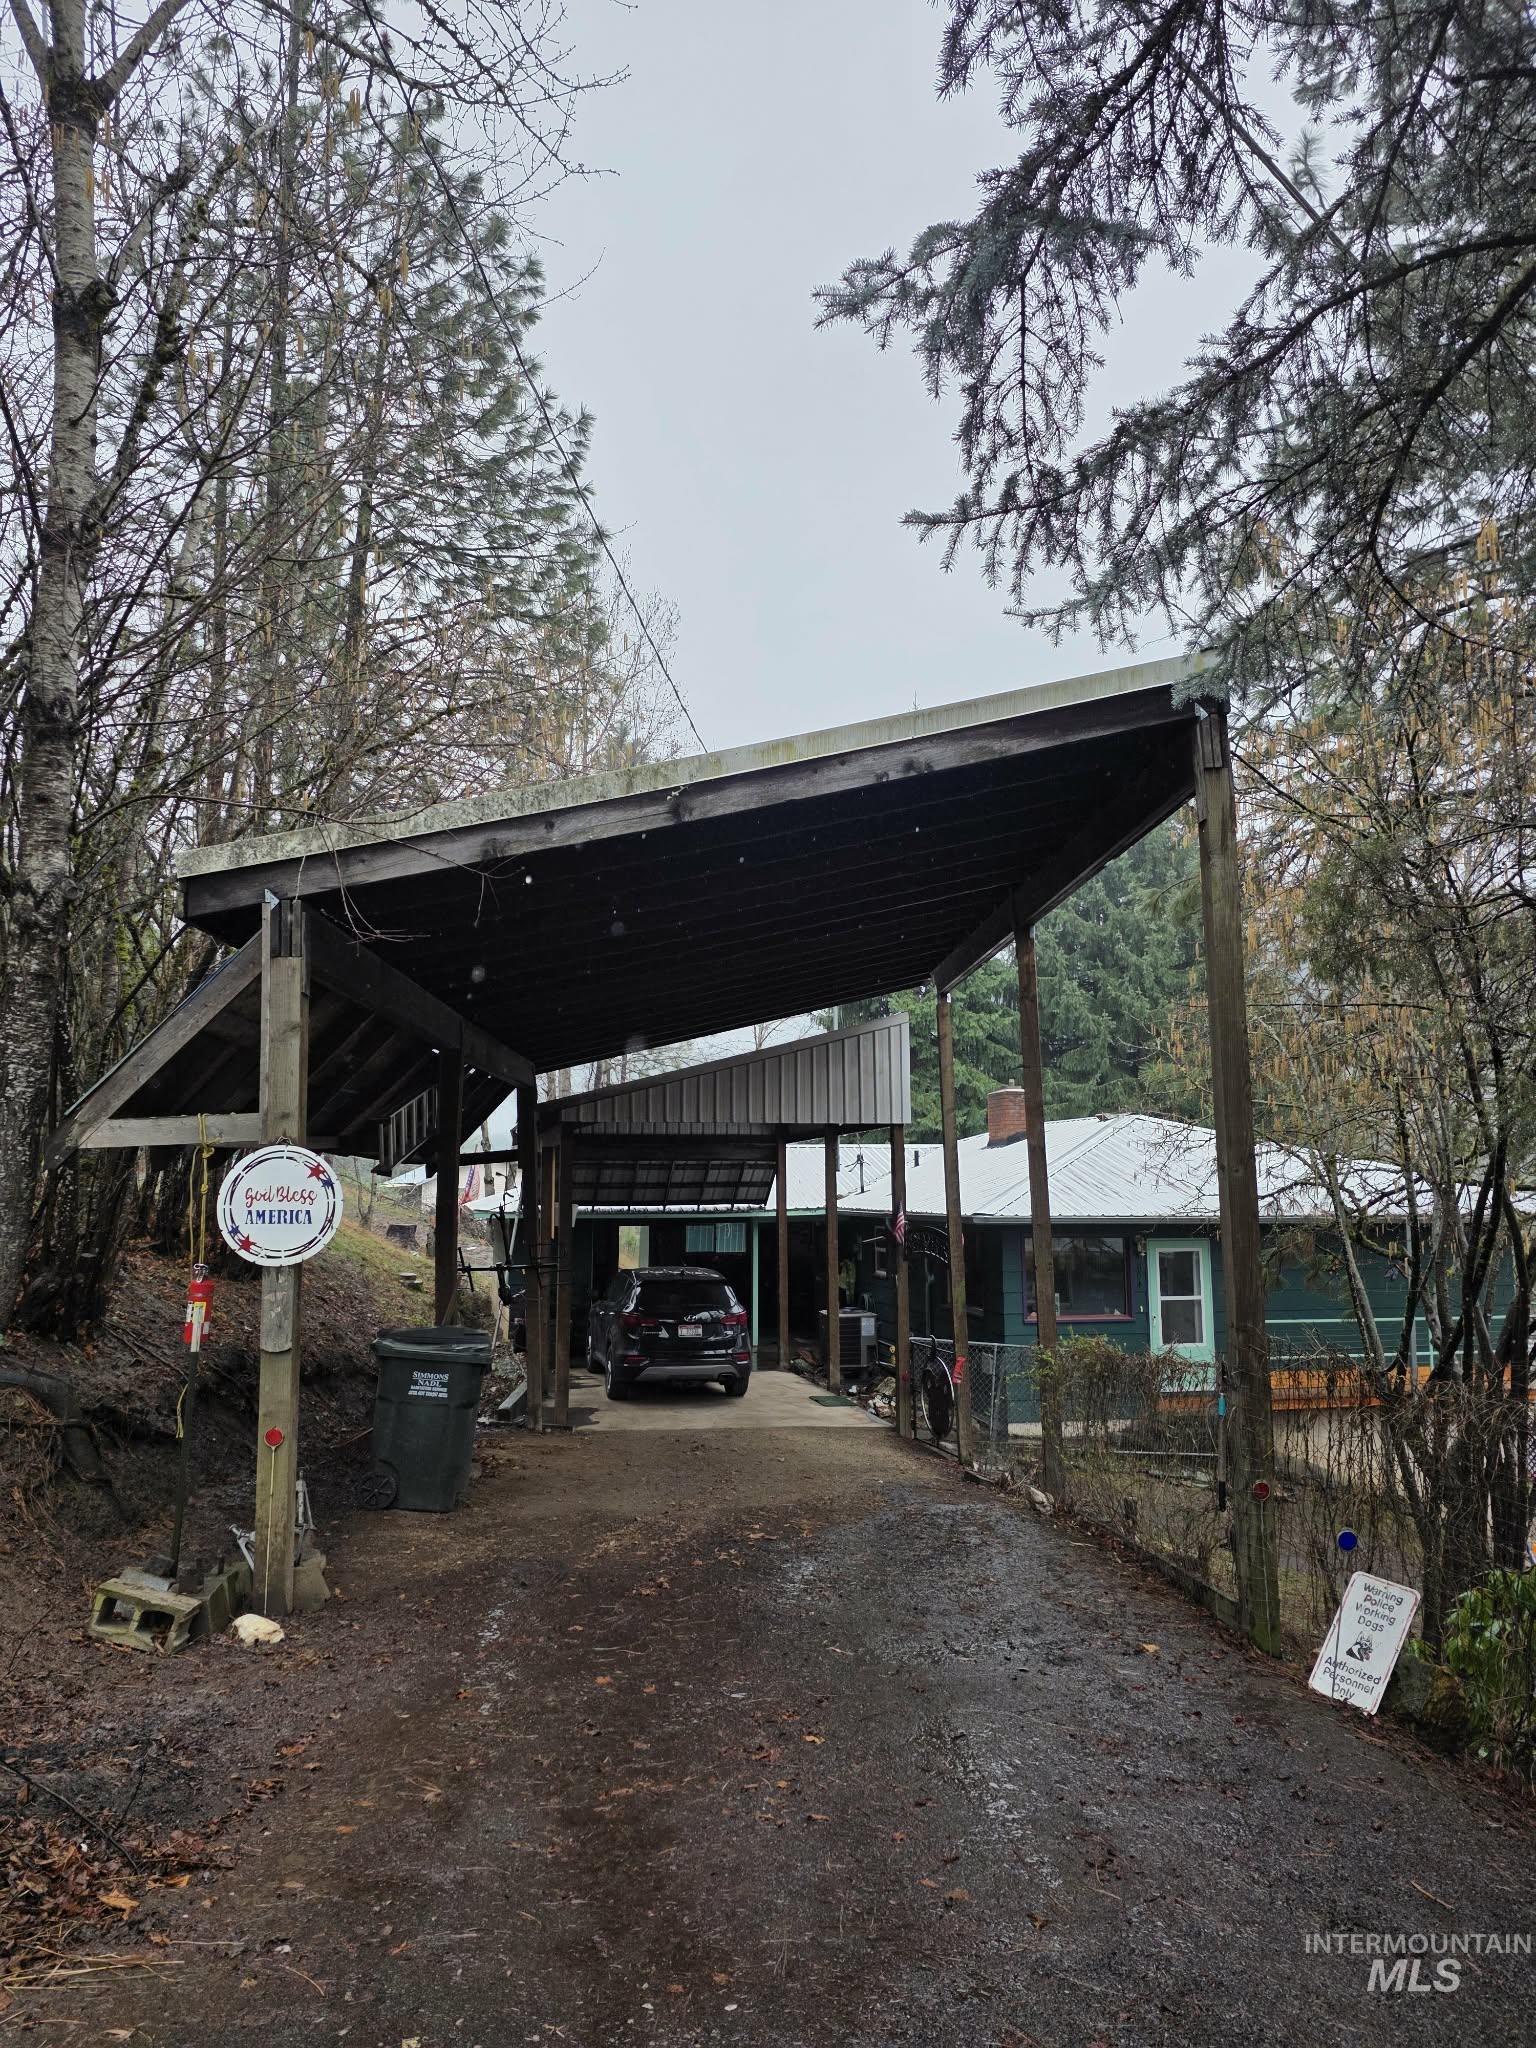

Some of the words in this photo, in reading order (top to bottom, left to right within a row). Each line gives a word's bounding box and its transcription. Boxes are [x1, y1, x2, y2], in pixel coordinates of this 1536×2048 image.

[245, 1185, 275, 1208] God
[276, 1185, 317, 1205] Bless
[245, 1209, 312, 1225] AMERICA
[412, 1371, 449, 1381] SIMMONS
[1363, 1594, 1395, 1613] Police
[1364, 1583, 1404, 1606] Warning
[1357, 1615, 1385, 1632] Dogs
[1324, 1656, 1382, 1685] Authorized
[1322, 1666, 1375, 1695] Personnel
[1332, 1682, 1356, 1700] Only
